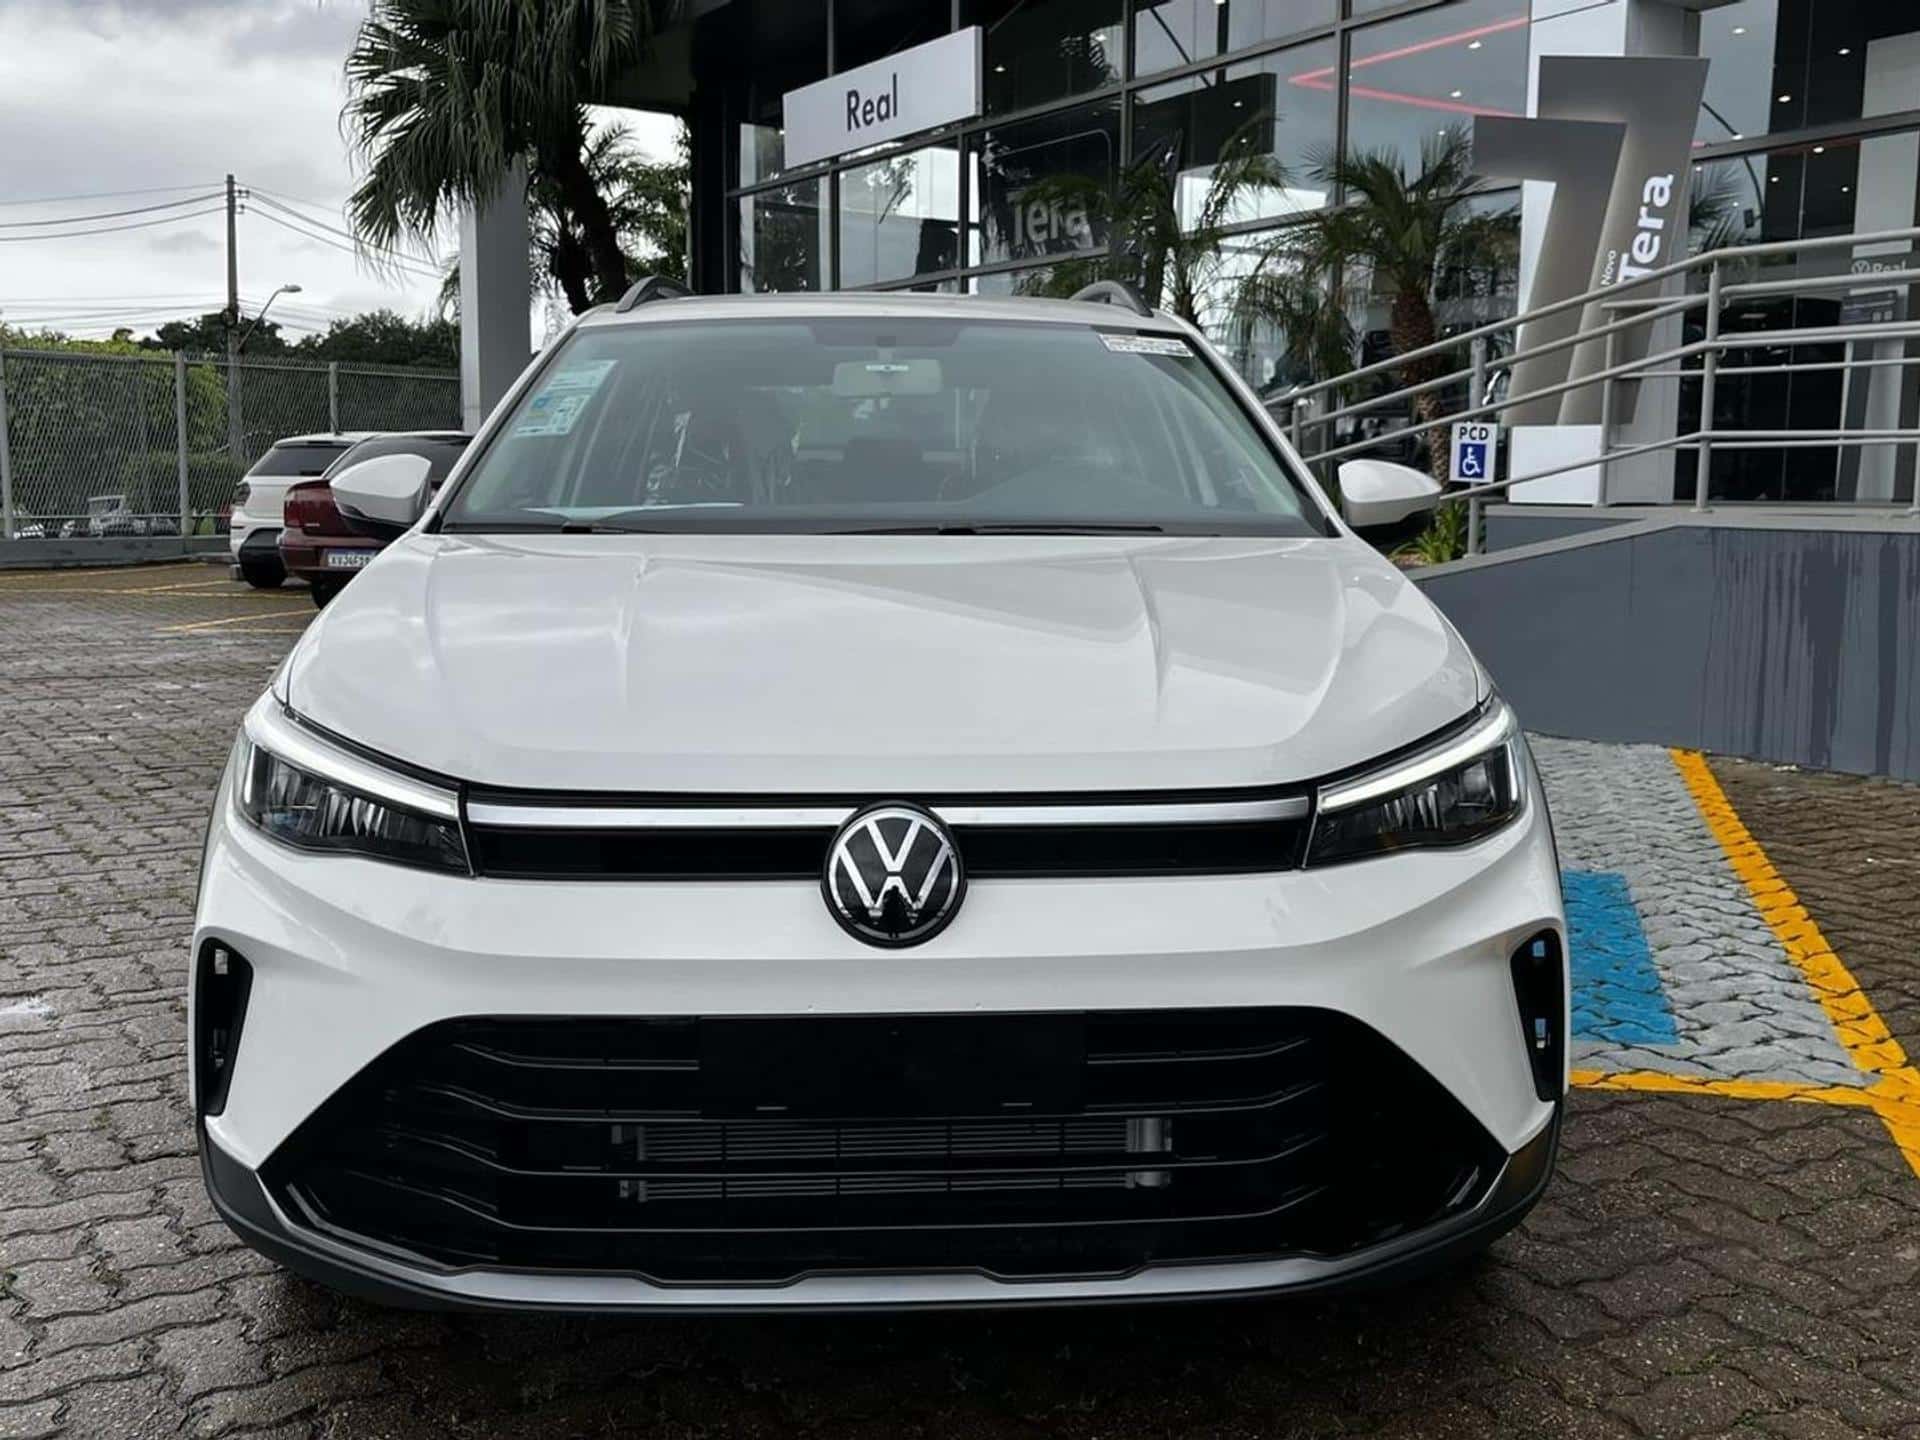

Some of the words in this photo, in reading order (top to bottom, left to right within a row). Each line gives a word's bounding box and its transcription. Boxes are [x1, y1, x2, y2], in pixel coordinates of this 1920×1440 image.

[846, 72, 897, 132] Real
[1006, 190, 1092, 245] Tera
[1617, 174, 1674, 283] Tera
[1600, 250, 1616, 286] Novo
[1459, 426, 1489, 440] PCD
